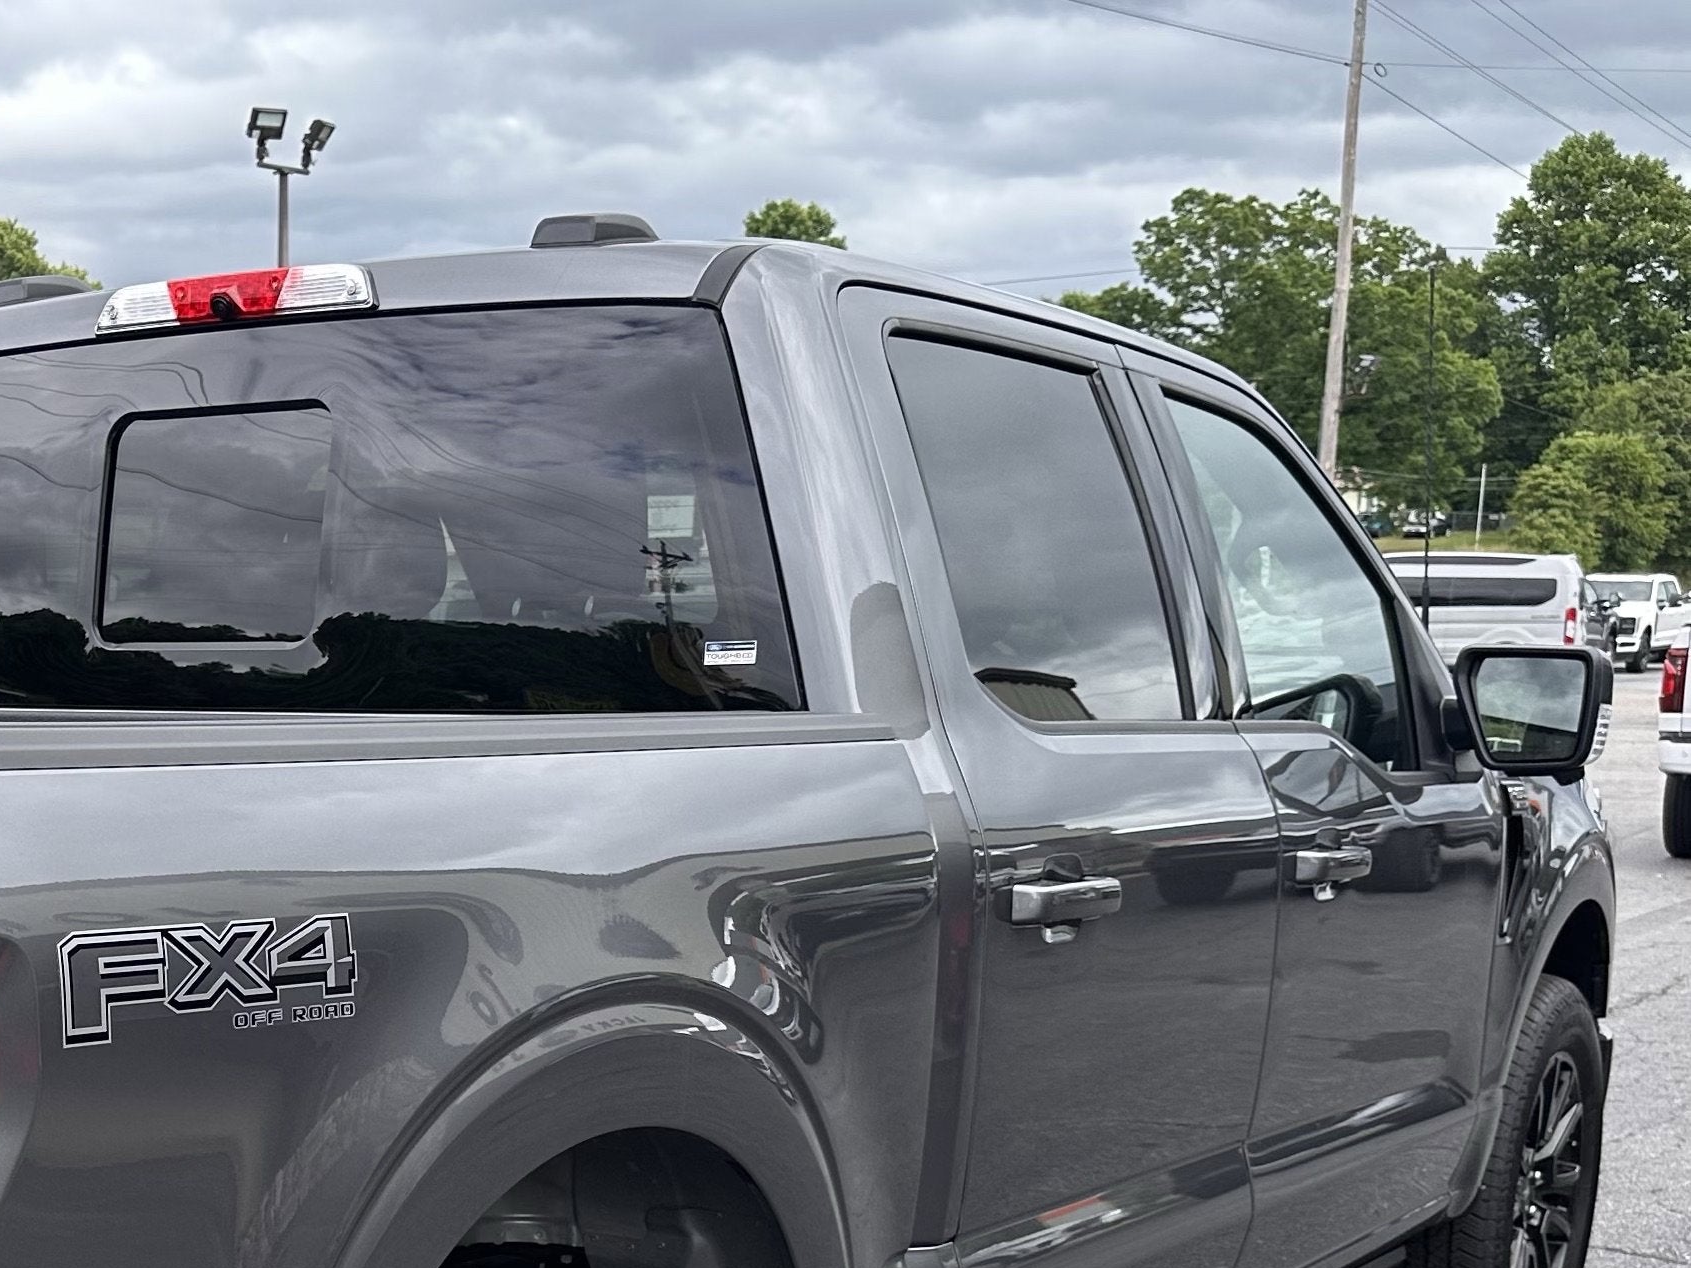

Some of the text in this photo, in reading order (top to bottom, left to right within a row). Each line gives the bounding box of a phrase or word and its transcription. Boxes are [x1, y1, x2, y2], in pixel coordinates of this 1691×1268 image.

[57, 912, 358, 1049] FX4
[232, 1001, 356, 1029] OFF ROAD
